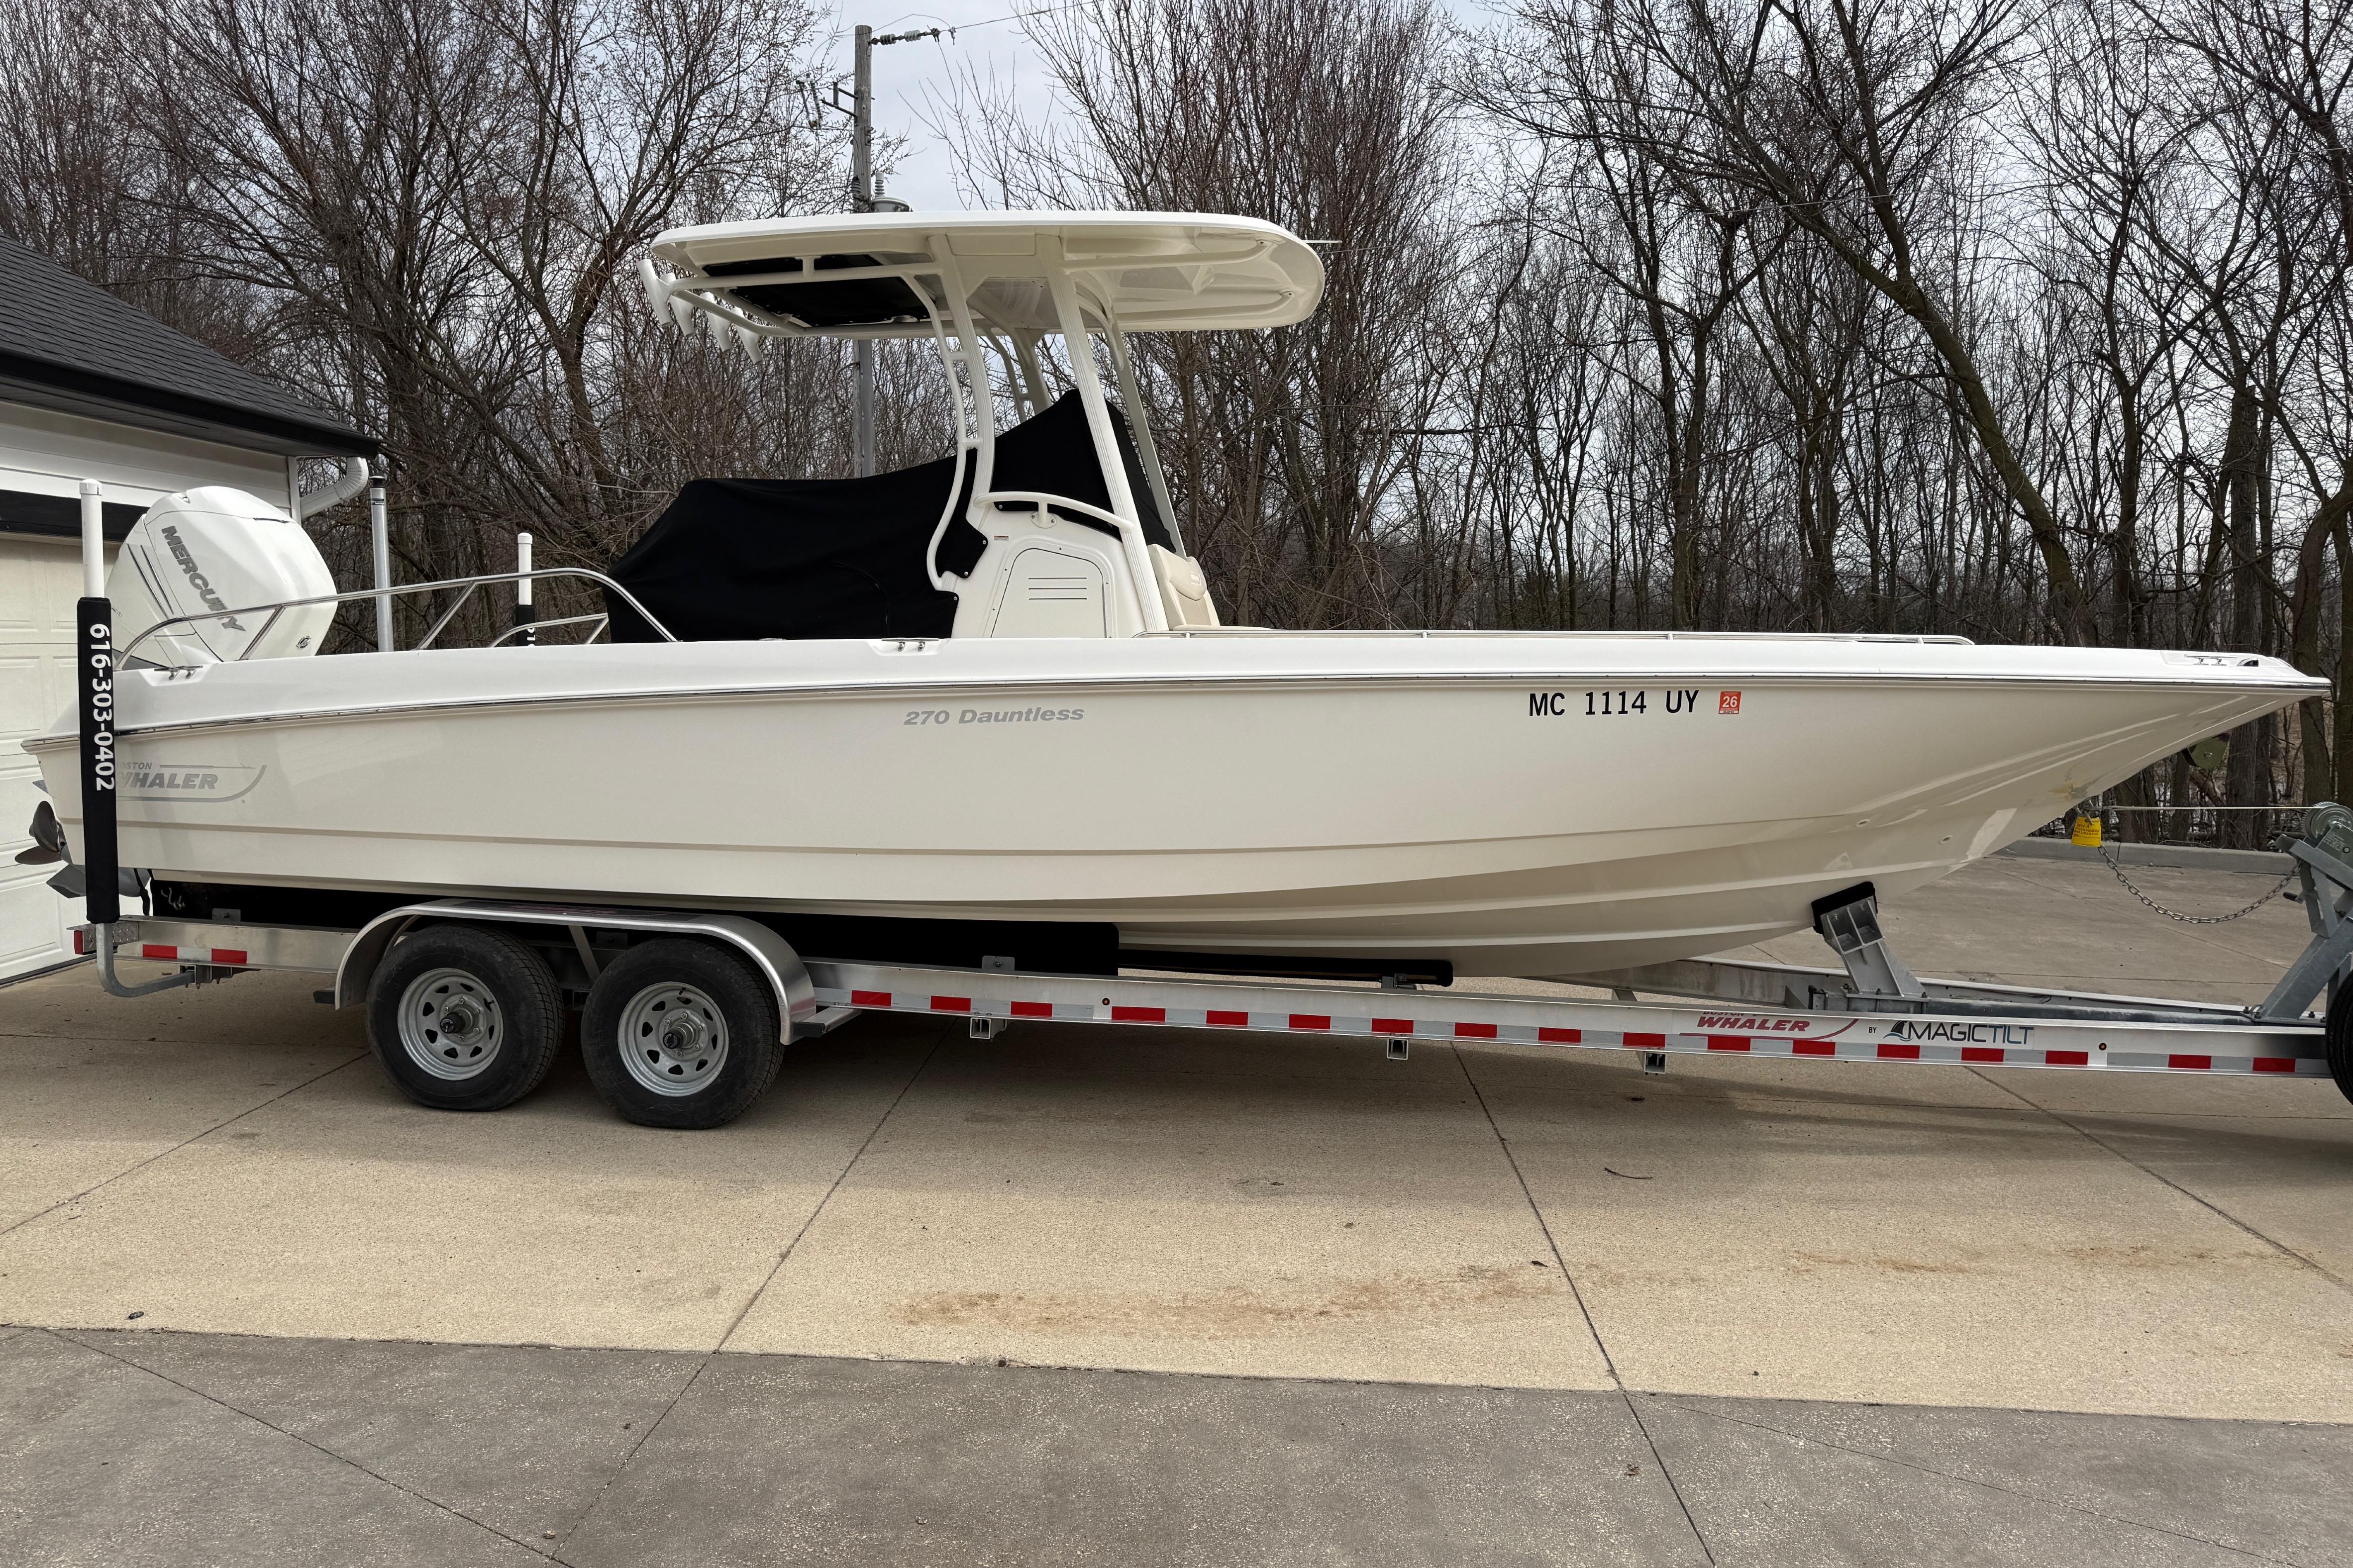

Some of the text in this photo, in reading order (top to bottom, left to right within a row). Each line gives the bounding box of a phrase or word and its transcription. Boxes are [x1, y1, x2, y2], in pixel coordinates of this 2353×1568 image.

[90, 623, 114, 791] 616-303-0402
[1529, 689, 1700, 716] MC 1114 UY
[1722, 696, 1738, 708] 26
[903, 707, 1085, 726] 270 Dauntless
[117, 762, 152, 770] OSTON
[1697, 1016, 1810, 1032] WHALER
[1908, 1020, 2034, 1045] MAGICTILT
